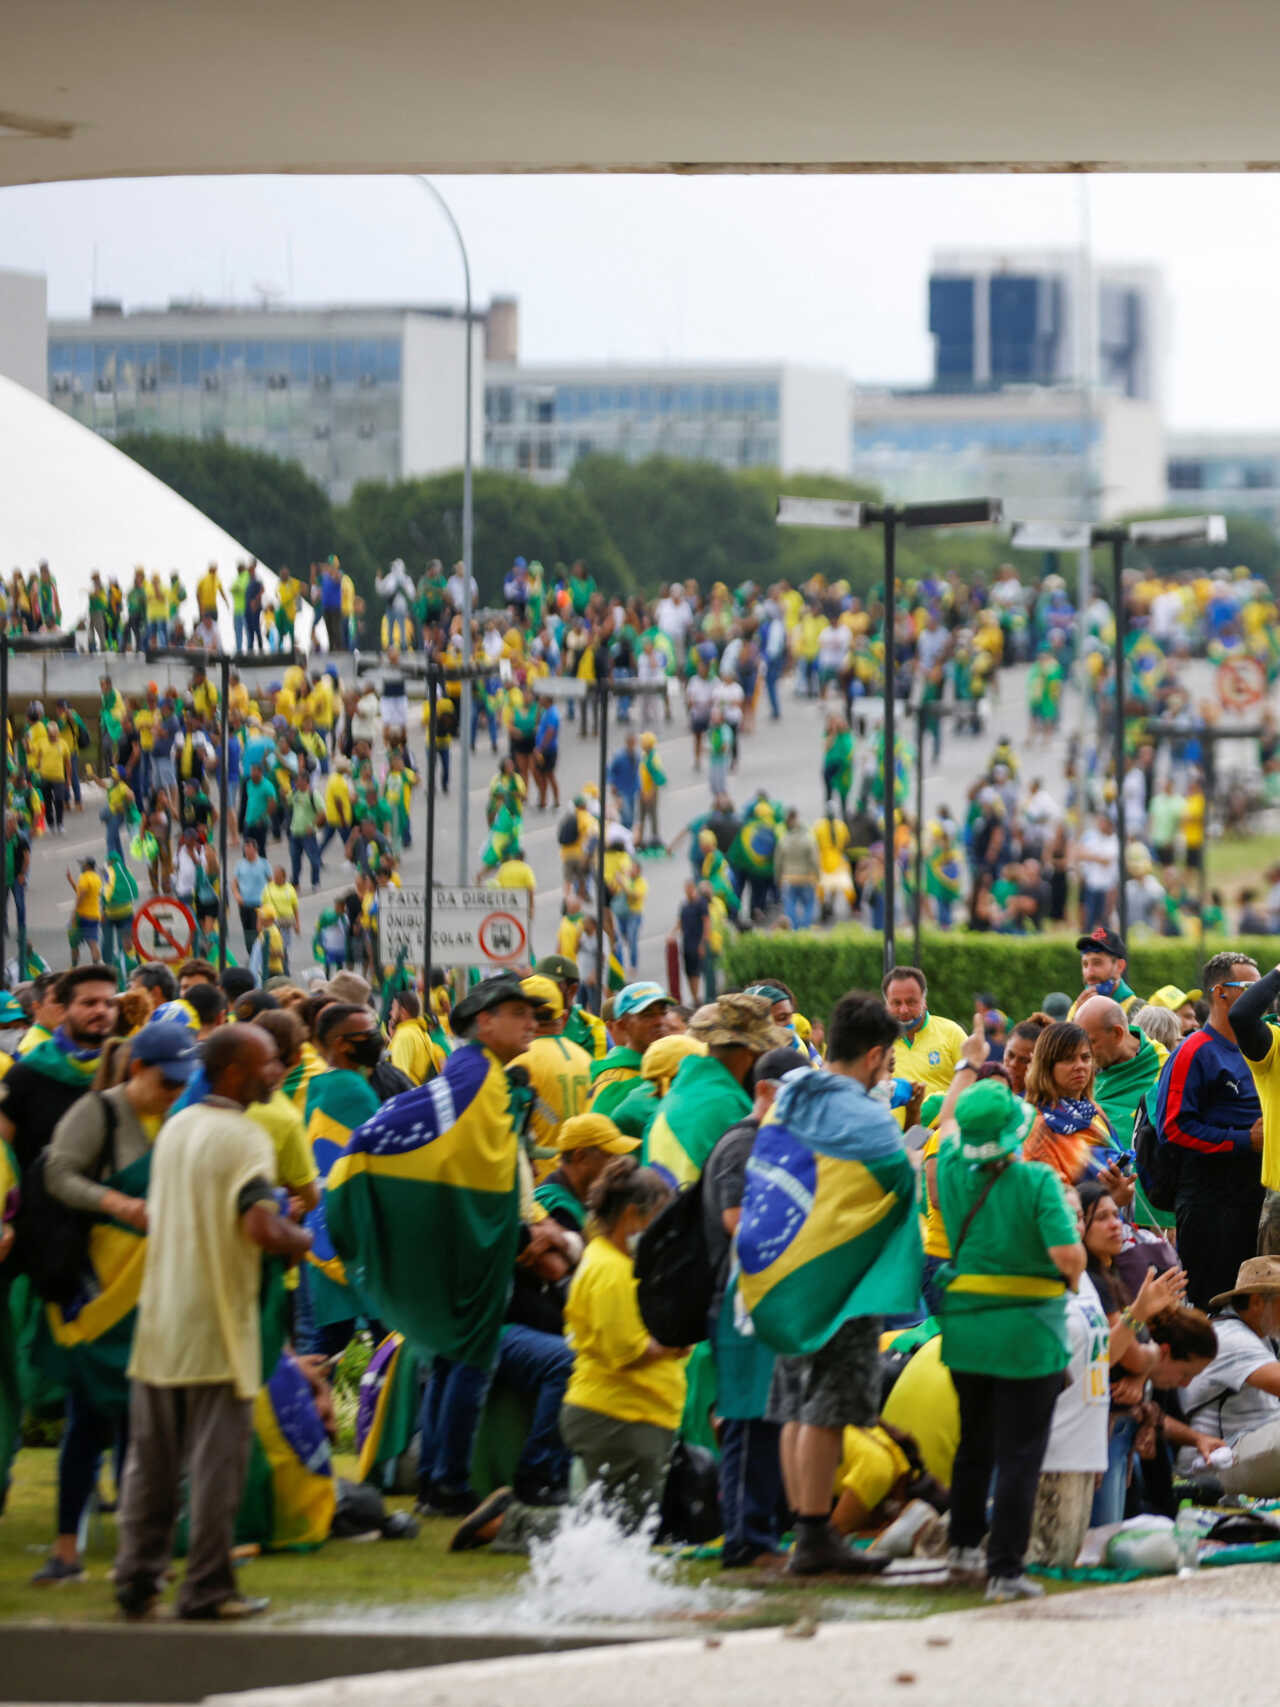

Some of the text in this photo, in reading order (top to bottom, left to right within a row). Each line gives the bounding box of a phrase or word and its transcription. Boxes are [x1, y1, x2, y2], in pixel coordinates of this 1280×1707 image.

[437, 891, 457, 905] DA
[462, 891, 519, 905] DIREITA
[387, 912, 425, 928] ÔNIBU
[386, 931, 473, 945] VAN ECOLAR
